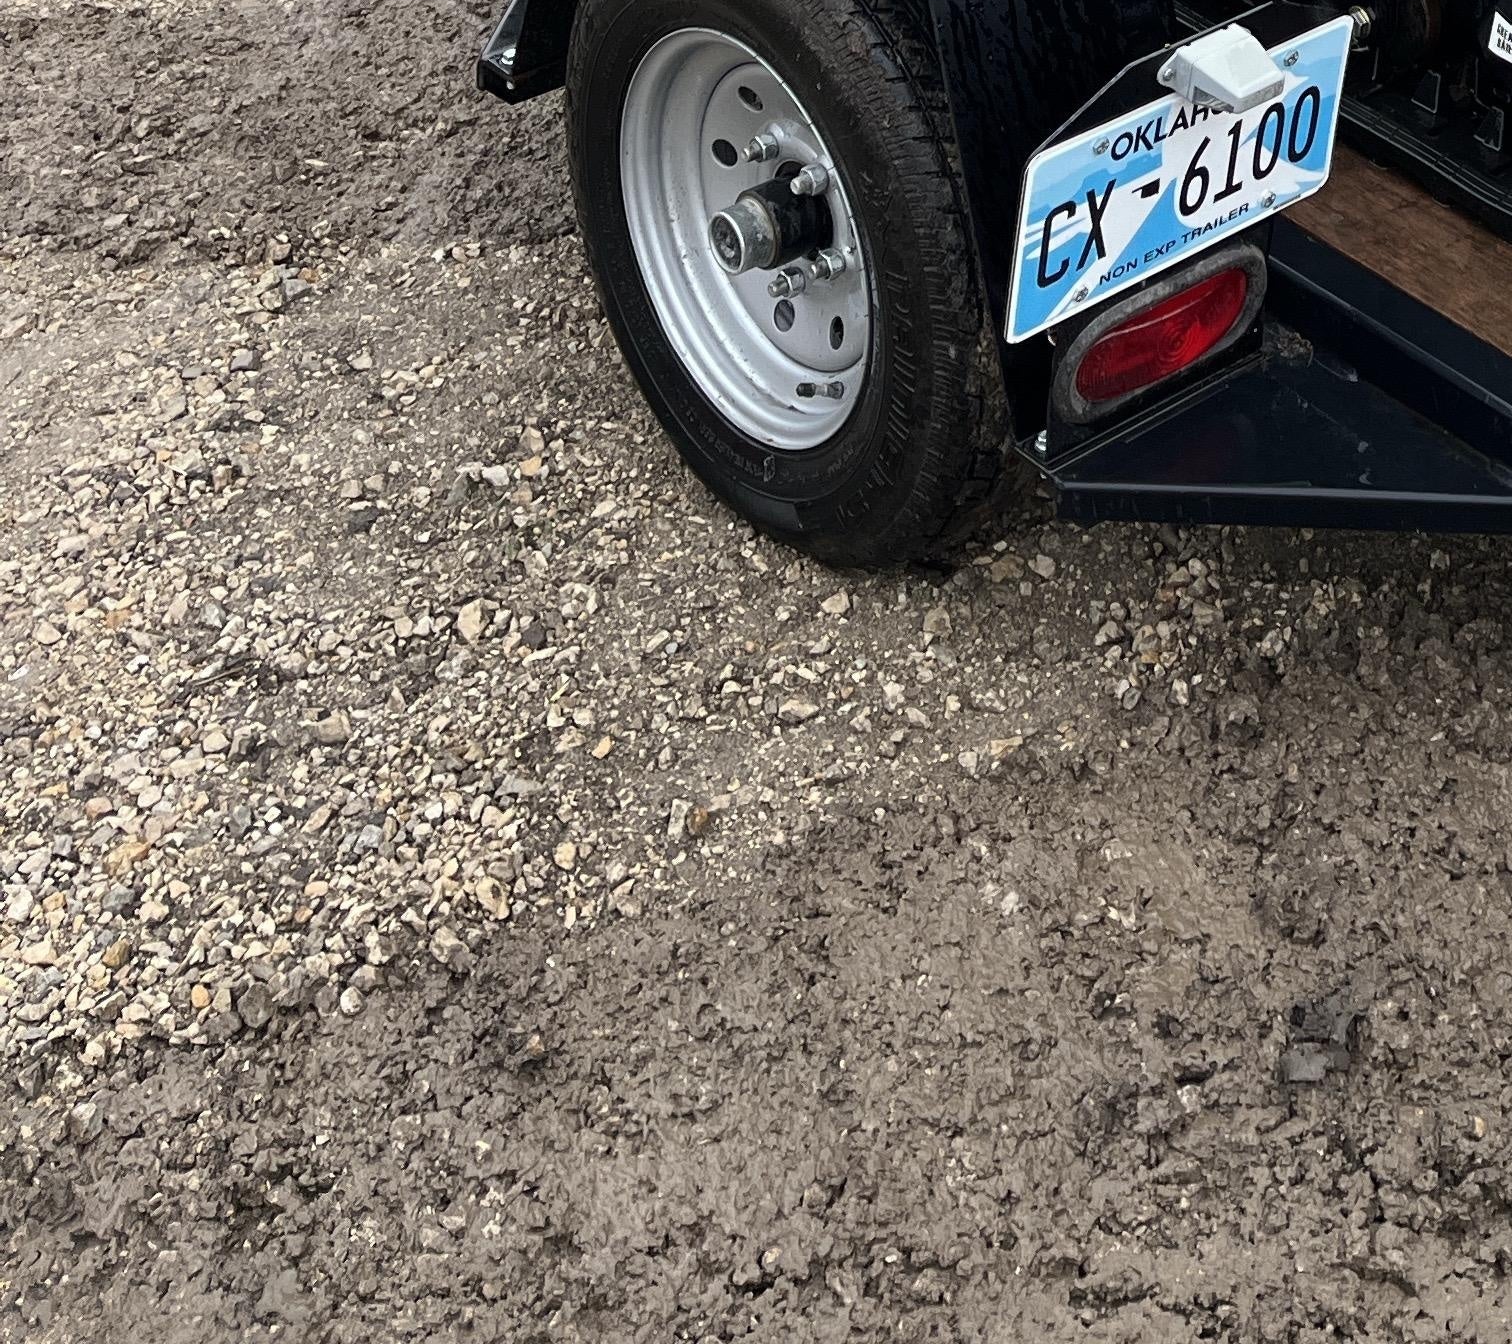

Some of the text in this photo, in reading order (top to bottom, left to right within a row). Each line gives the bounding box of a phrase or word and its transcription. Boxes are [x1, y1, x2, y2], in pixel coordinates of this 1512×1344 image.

[1110, 106, 1223, 161] OKLAH
[1036, 85, 1321, 289] CX 6100
[1099, 258, 1138, 286] NON
[1142, 239, 1177, 263] EXP
[1181, 202, 1250, 245] TRAILER
